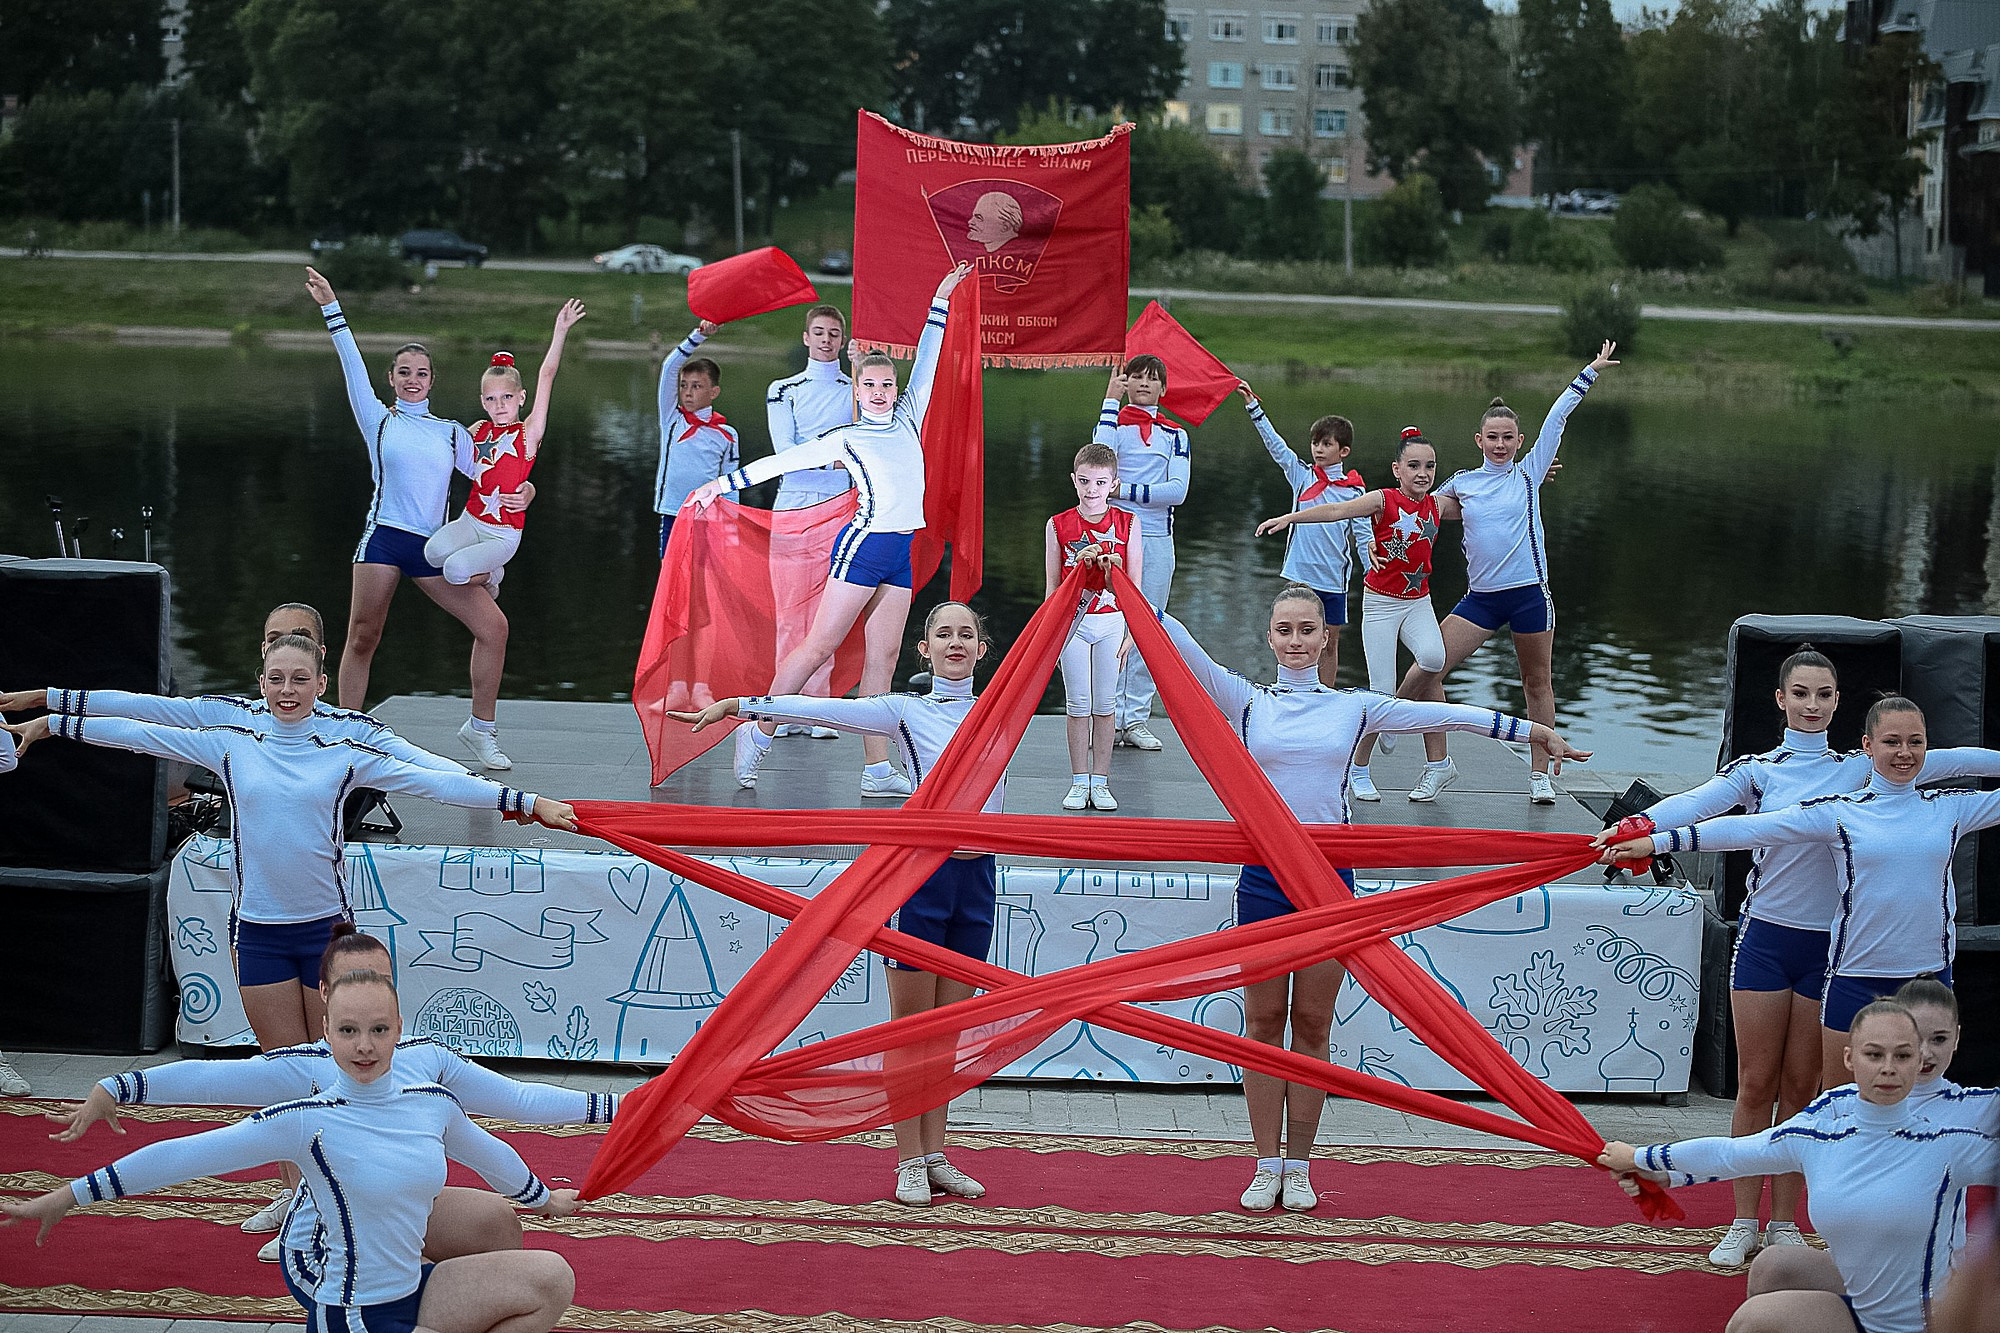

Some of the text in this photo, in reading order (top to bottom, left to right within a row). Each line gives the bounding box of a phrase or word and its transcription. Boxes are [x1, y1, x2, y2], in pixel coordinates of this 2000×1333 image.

[1039, 156, 1092, 171] ЗНАМЯ
[1017, 316, 1058, 328] ОБКОМ
[980, 331, 1015, 345] ЛКСМ
